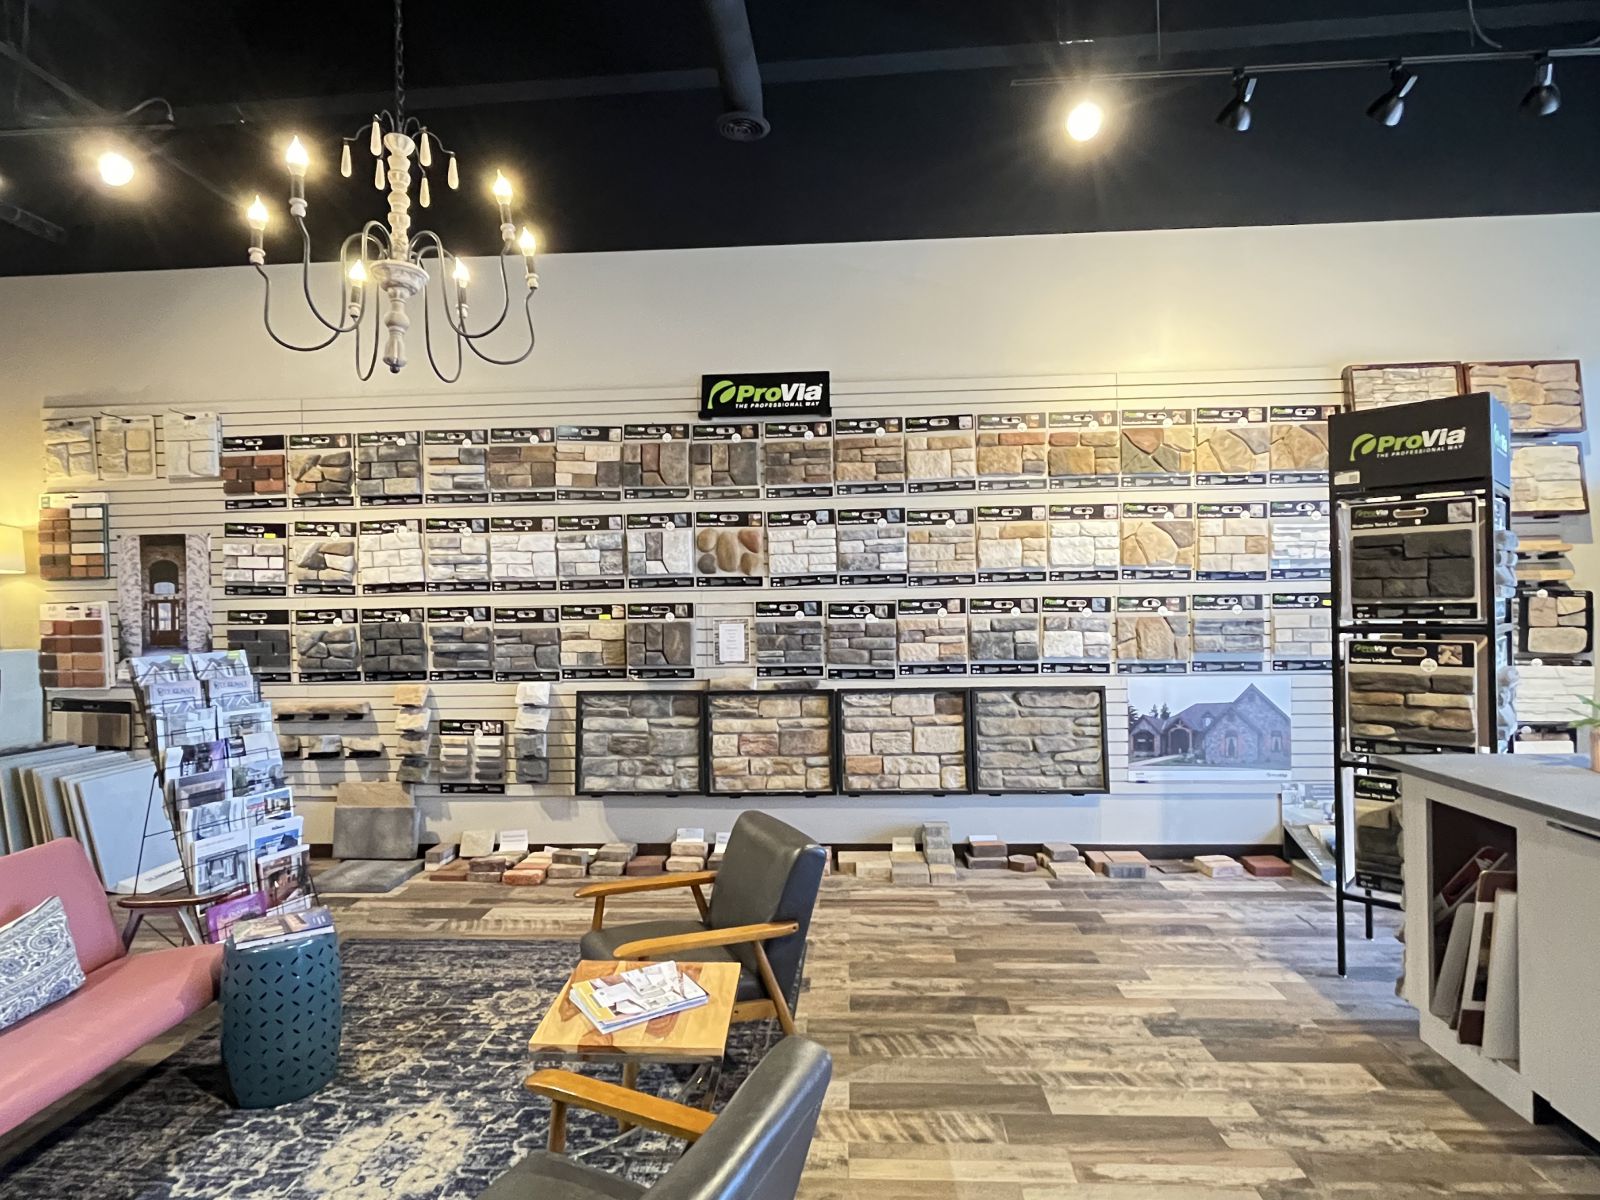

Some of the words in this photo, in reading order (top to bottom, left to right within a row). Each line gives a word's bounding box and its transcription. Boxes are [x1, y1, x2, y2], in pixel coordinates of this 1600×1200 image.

[736, 383, 822, 402] ProVia
[1377, 428, 1465, 452] ProVia
[1391, 447, 1445, 457] PROFESSIONAL
